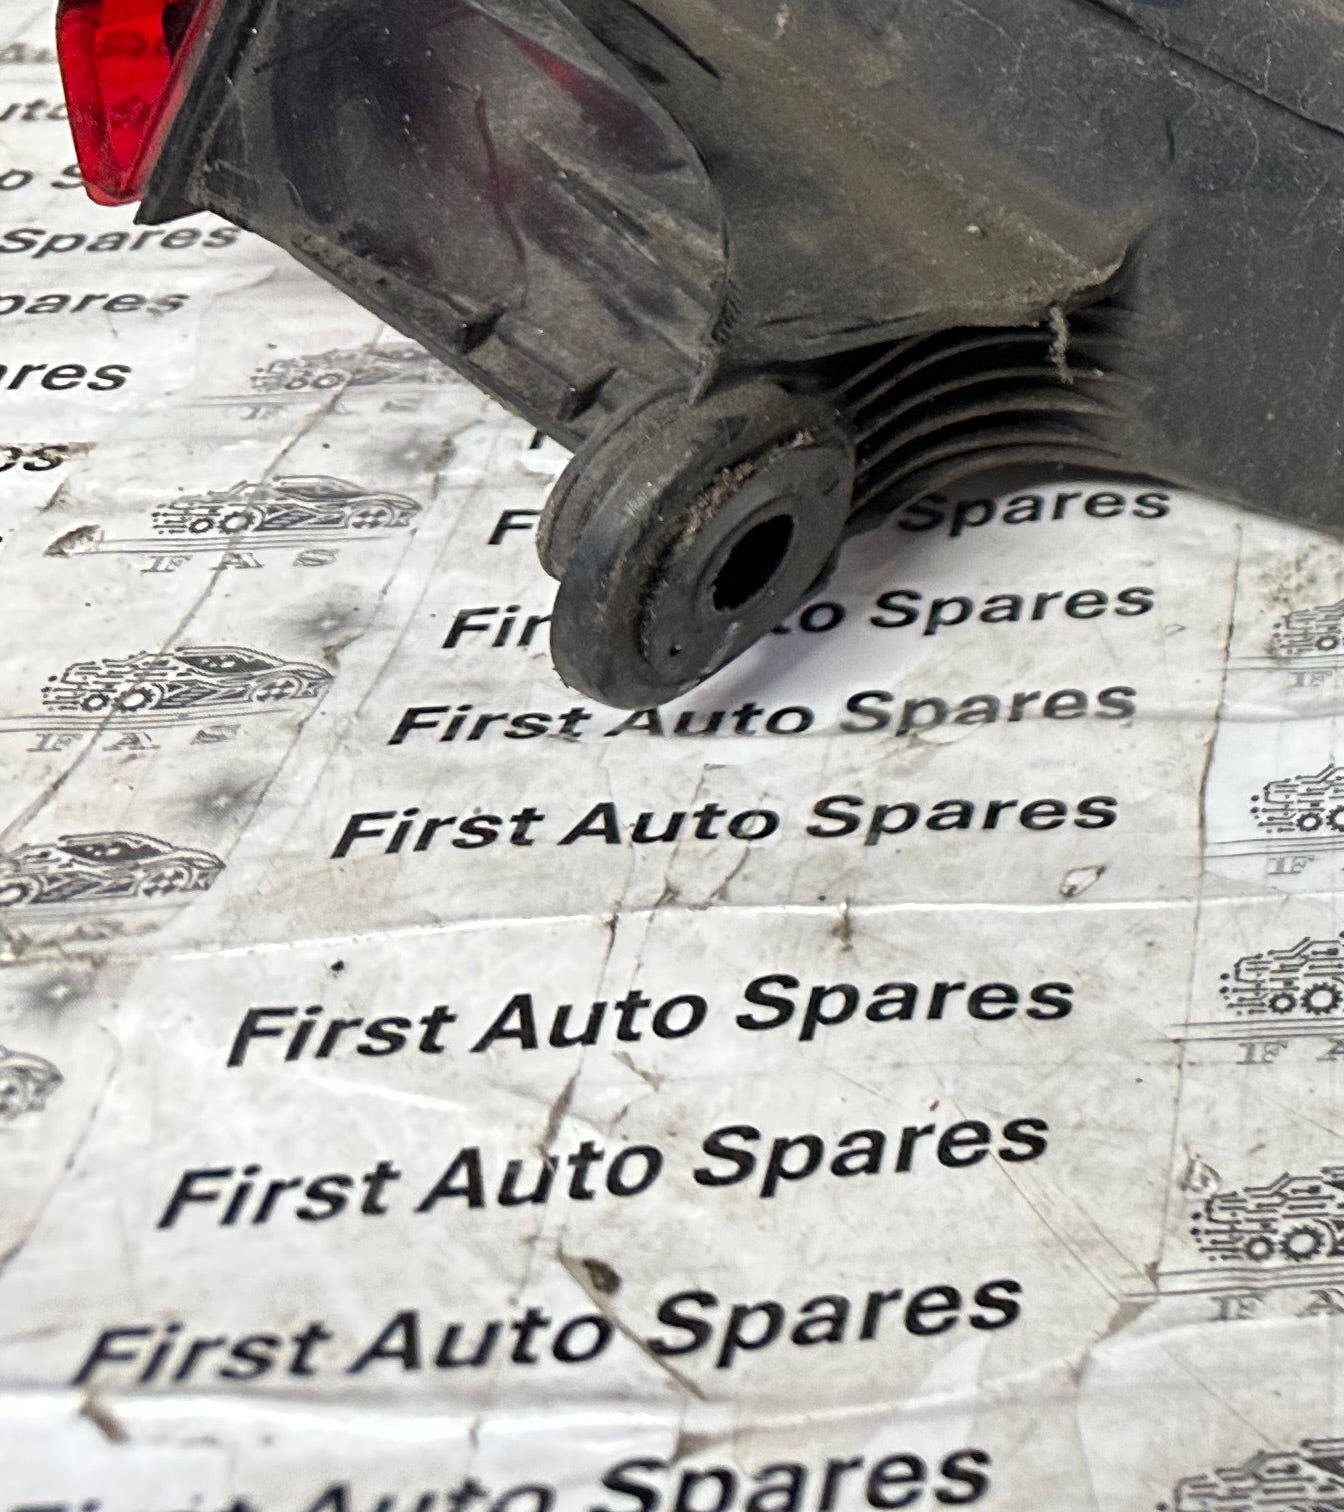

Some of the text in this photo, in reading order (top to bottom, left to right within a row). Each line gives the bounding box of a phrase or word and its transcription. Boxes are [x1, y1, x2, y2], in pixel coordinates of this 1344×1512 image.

[0, 220, 243, 260] Spares
[896, 486, 1170, 540] Spares
[440, 602, 554, 652] Fir
[868, 582, 1155, 637] Spares
[386, 685, 1137, 746] First Auto Spares
[329, 794, 1118, 860] First Auto Spares
[226, 973, 1075, 1068] First Auto Spares
[156, 1117, 1050, 1230] First Auto Spares
[70, 1279, 1023, 1388] First Auto Spares
